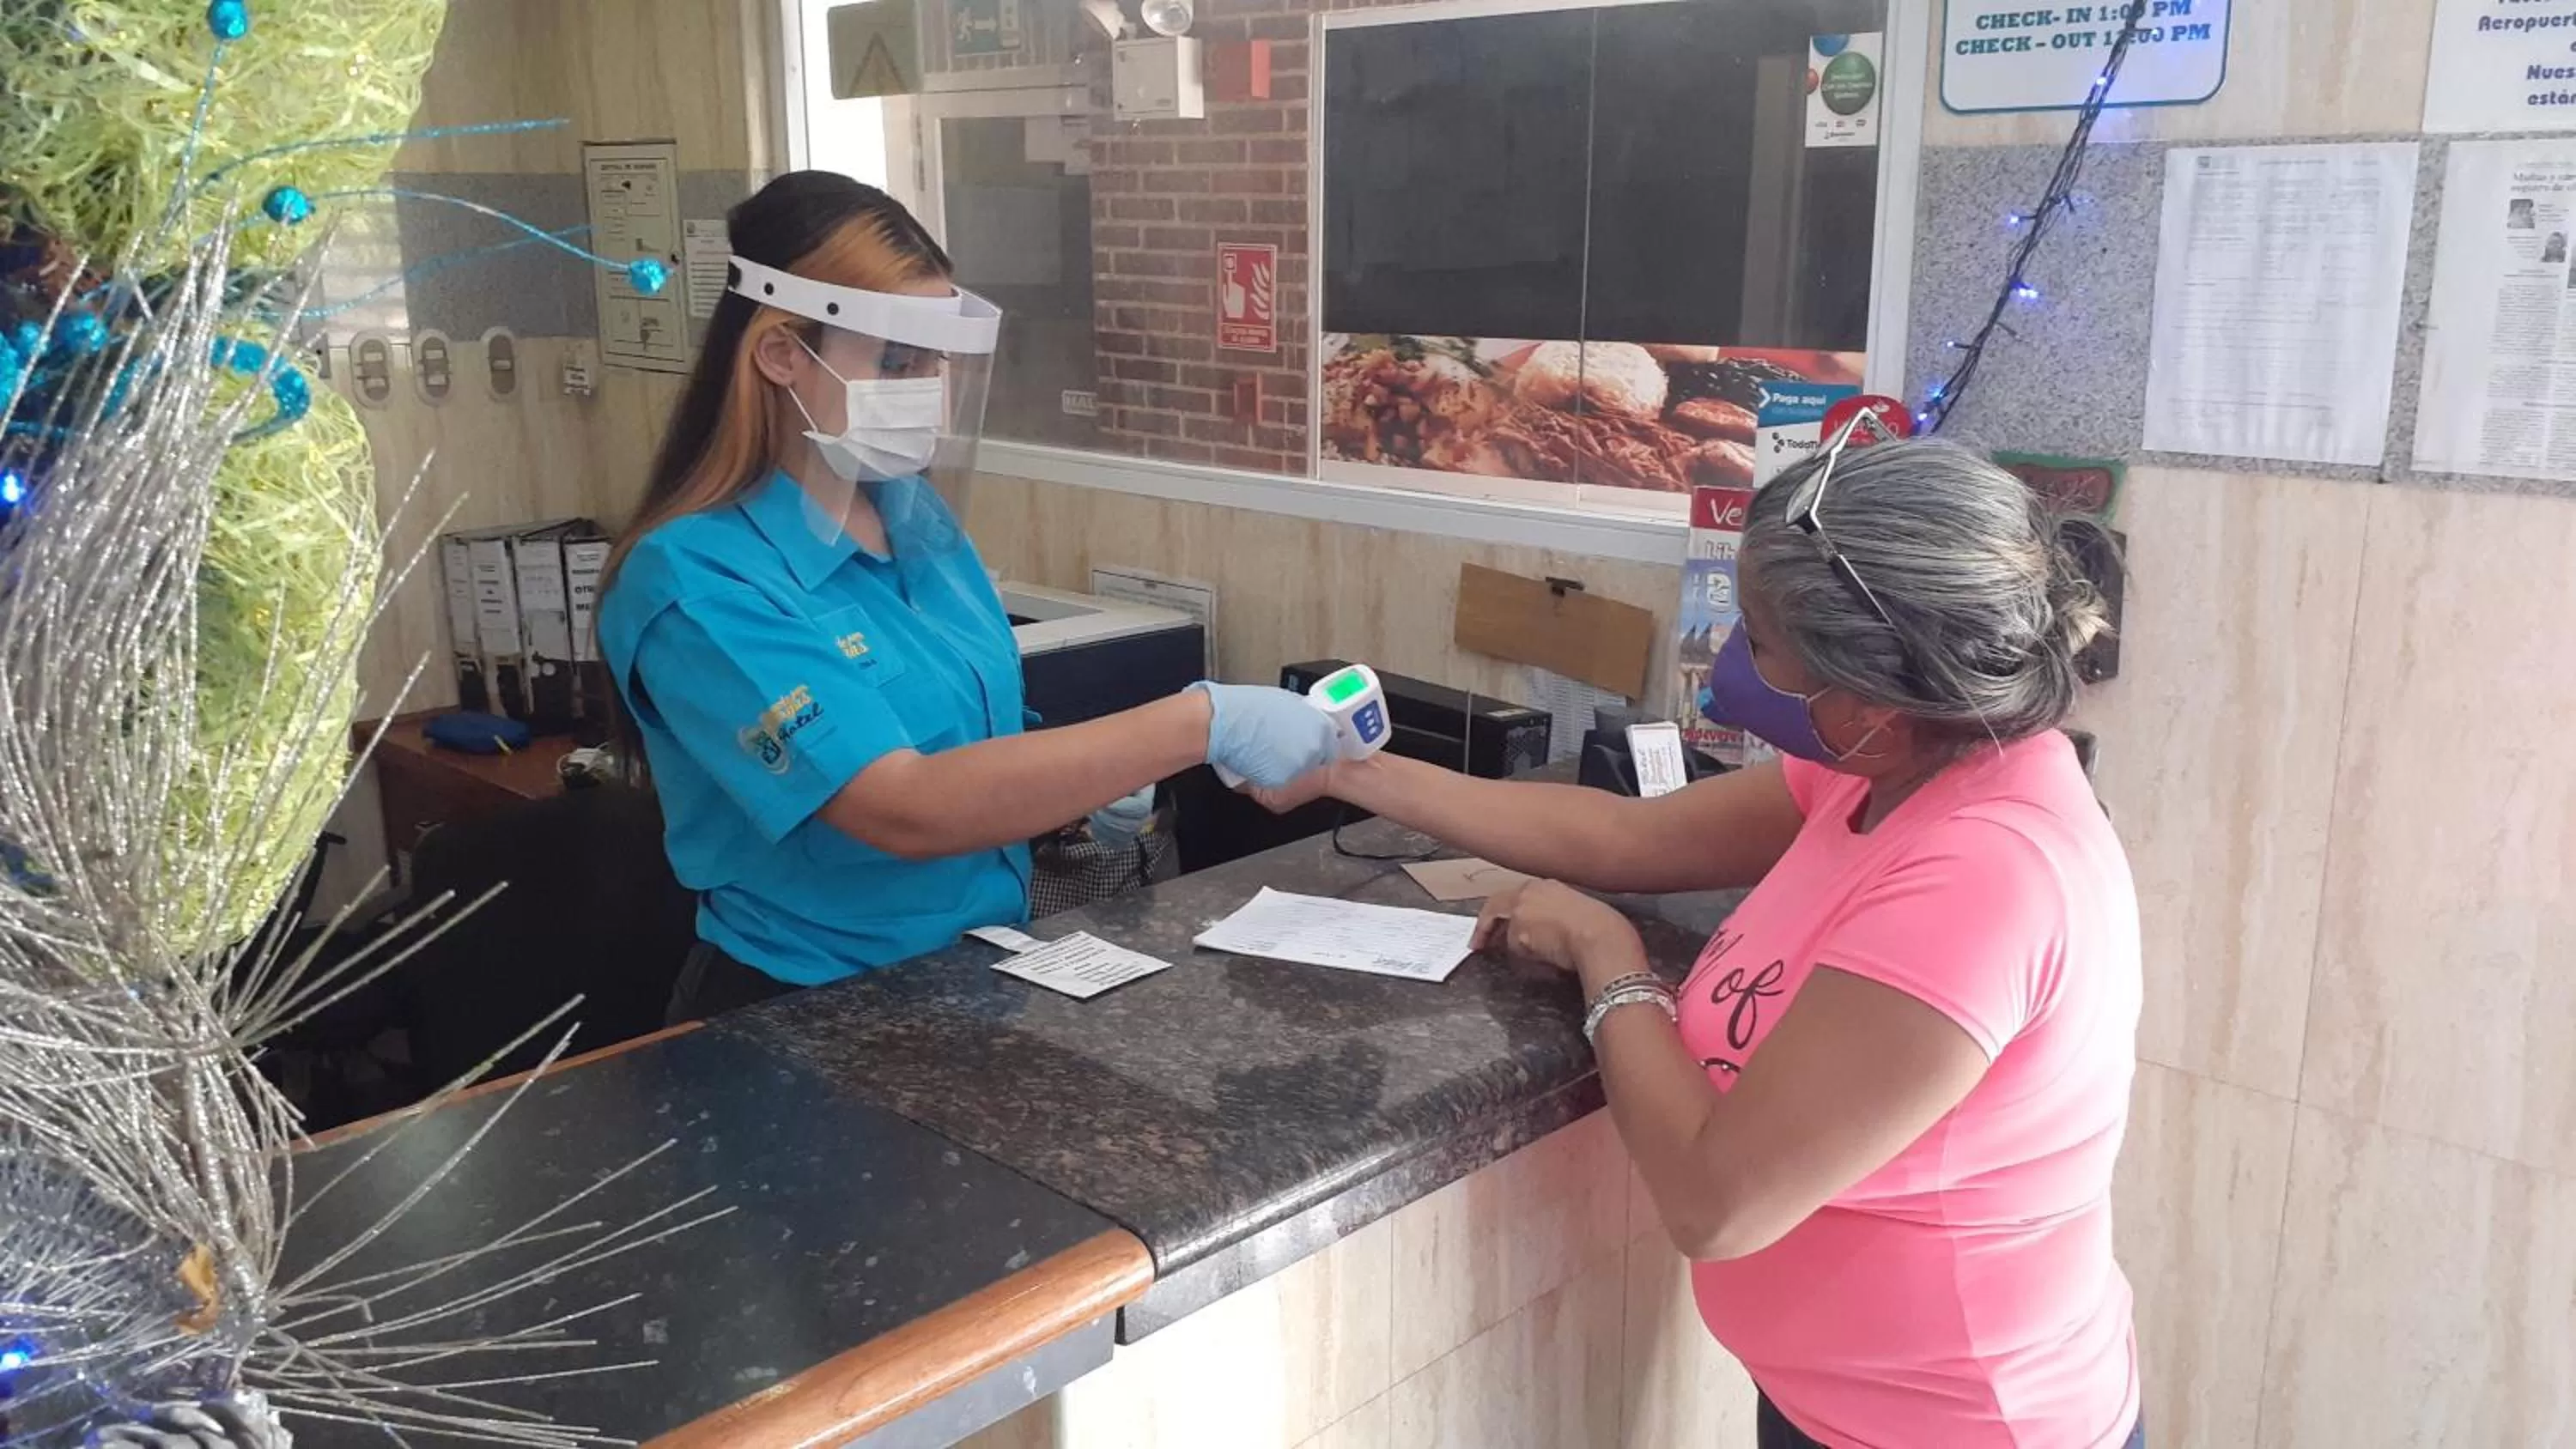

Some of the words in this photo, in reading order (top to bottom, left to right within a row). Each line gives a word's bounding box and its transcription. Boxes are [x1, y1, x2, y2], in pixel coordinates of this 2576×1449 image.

[2066, 7, 2093, 24] IN
[2099, 3, 2146, 21] 1:0
[2152, 0, 2192, 17] PM
[1955, 36, 2032, 55] CHECK
[2051, 32, 2097, 49] OUT
[2170, 23, 2212, 41] PM
[1710, 959, 1785, 1050] of
